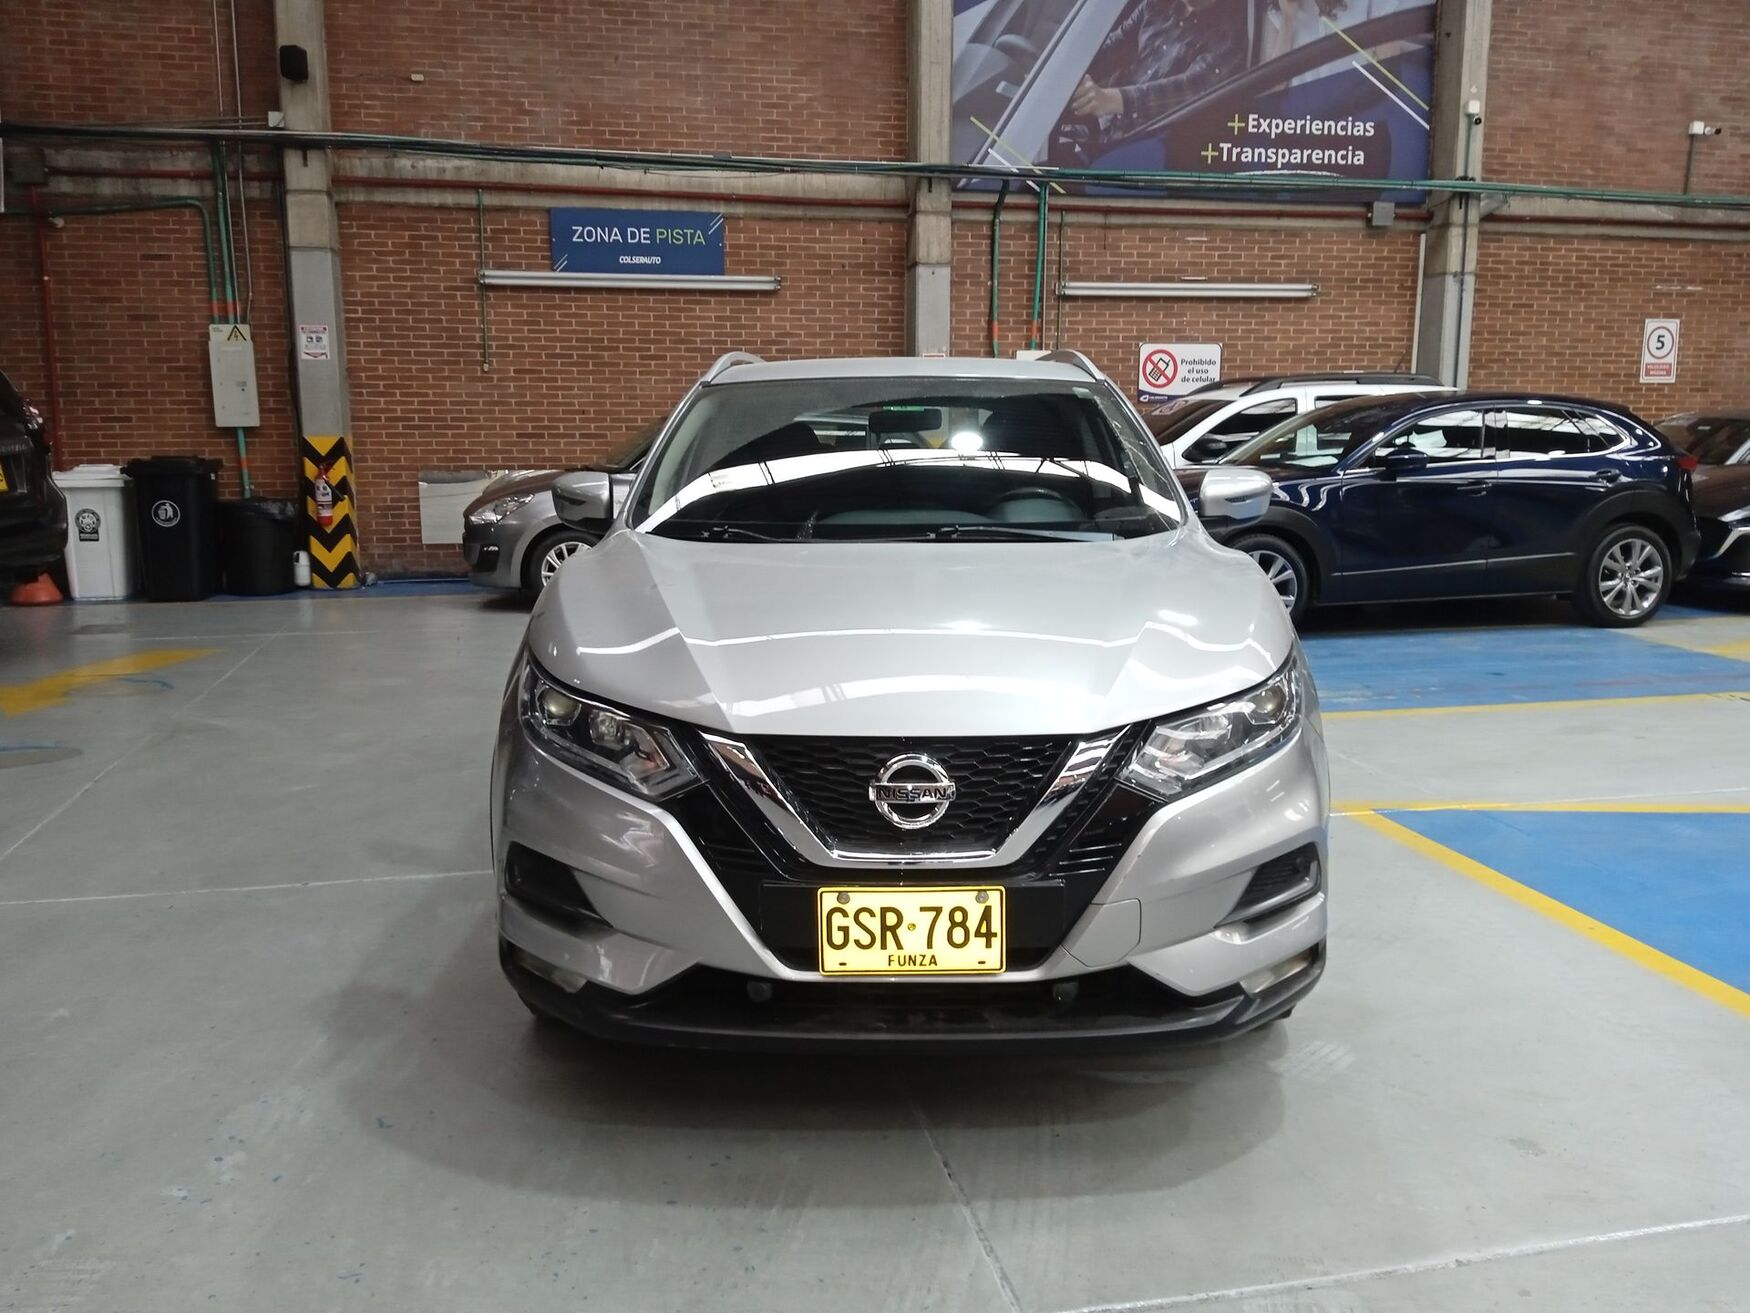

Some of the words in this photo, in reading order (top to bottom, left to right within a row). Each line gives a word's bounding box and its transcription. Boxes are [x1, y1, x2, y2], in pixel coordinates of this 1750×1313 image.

[571, 226, 623, 243] ZONA
[627, 227, 651, 244] DE
[656, 228, 706, 246] PISTA
[619, 255, 662, 265] COLSERAUTO
[1655, 334, 1666, 350] 5
[1180, 358, 1217, 367] Prohibido
[1187, 367, 1195, 375] el
[1181, 375, 1191, 383] de
[1191, 375, 1216, 384] celular
[875, 786, 948, 801] NISSAN
[825, 906, 904, 951] GSR
[919, 905, 998, 950] 784
[887, 954, 938, 967] FUNZA
